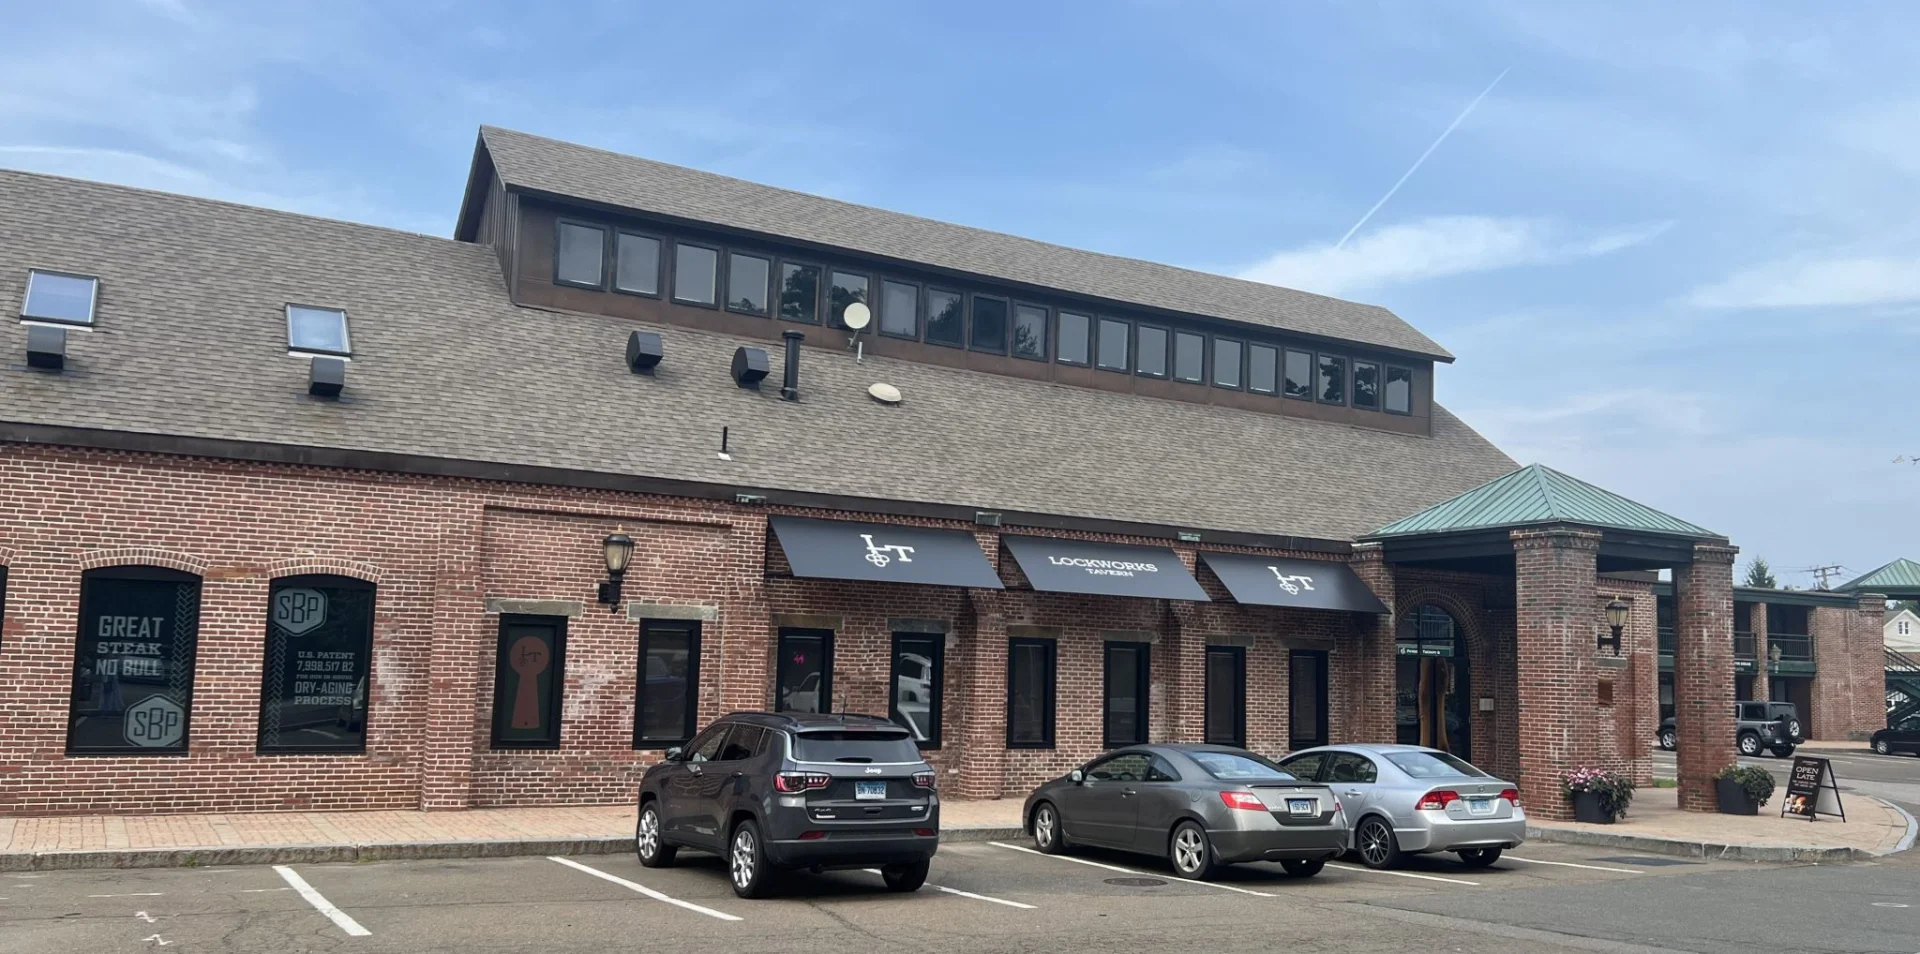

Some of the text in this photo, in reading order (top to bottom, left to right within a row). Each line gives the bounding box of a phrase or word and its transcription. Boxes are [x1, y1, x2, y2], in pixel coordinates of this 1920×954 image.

[1048, 556, 1158, 572] LOCKWORKS
[1085, 568, 1134, 577] TAVERN
[278, 592, 318, 623] SBP
[98, 615, 164, 638] GREAT
[96, 641, 162, 655] STEAK
[317, 651, 355, 659] PATENT
[95, 659, 160, 676] NO BULL
[341, 661, 354, 672] B2
[295, 681, 353, 694] DRY-AGING
[294, 696, 352, 705] PROCESS
[133, 707, 178, 740] SBP
[865, 766, 882, 774] Jeep
[1795, 766, 1819, 775] OPEN
